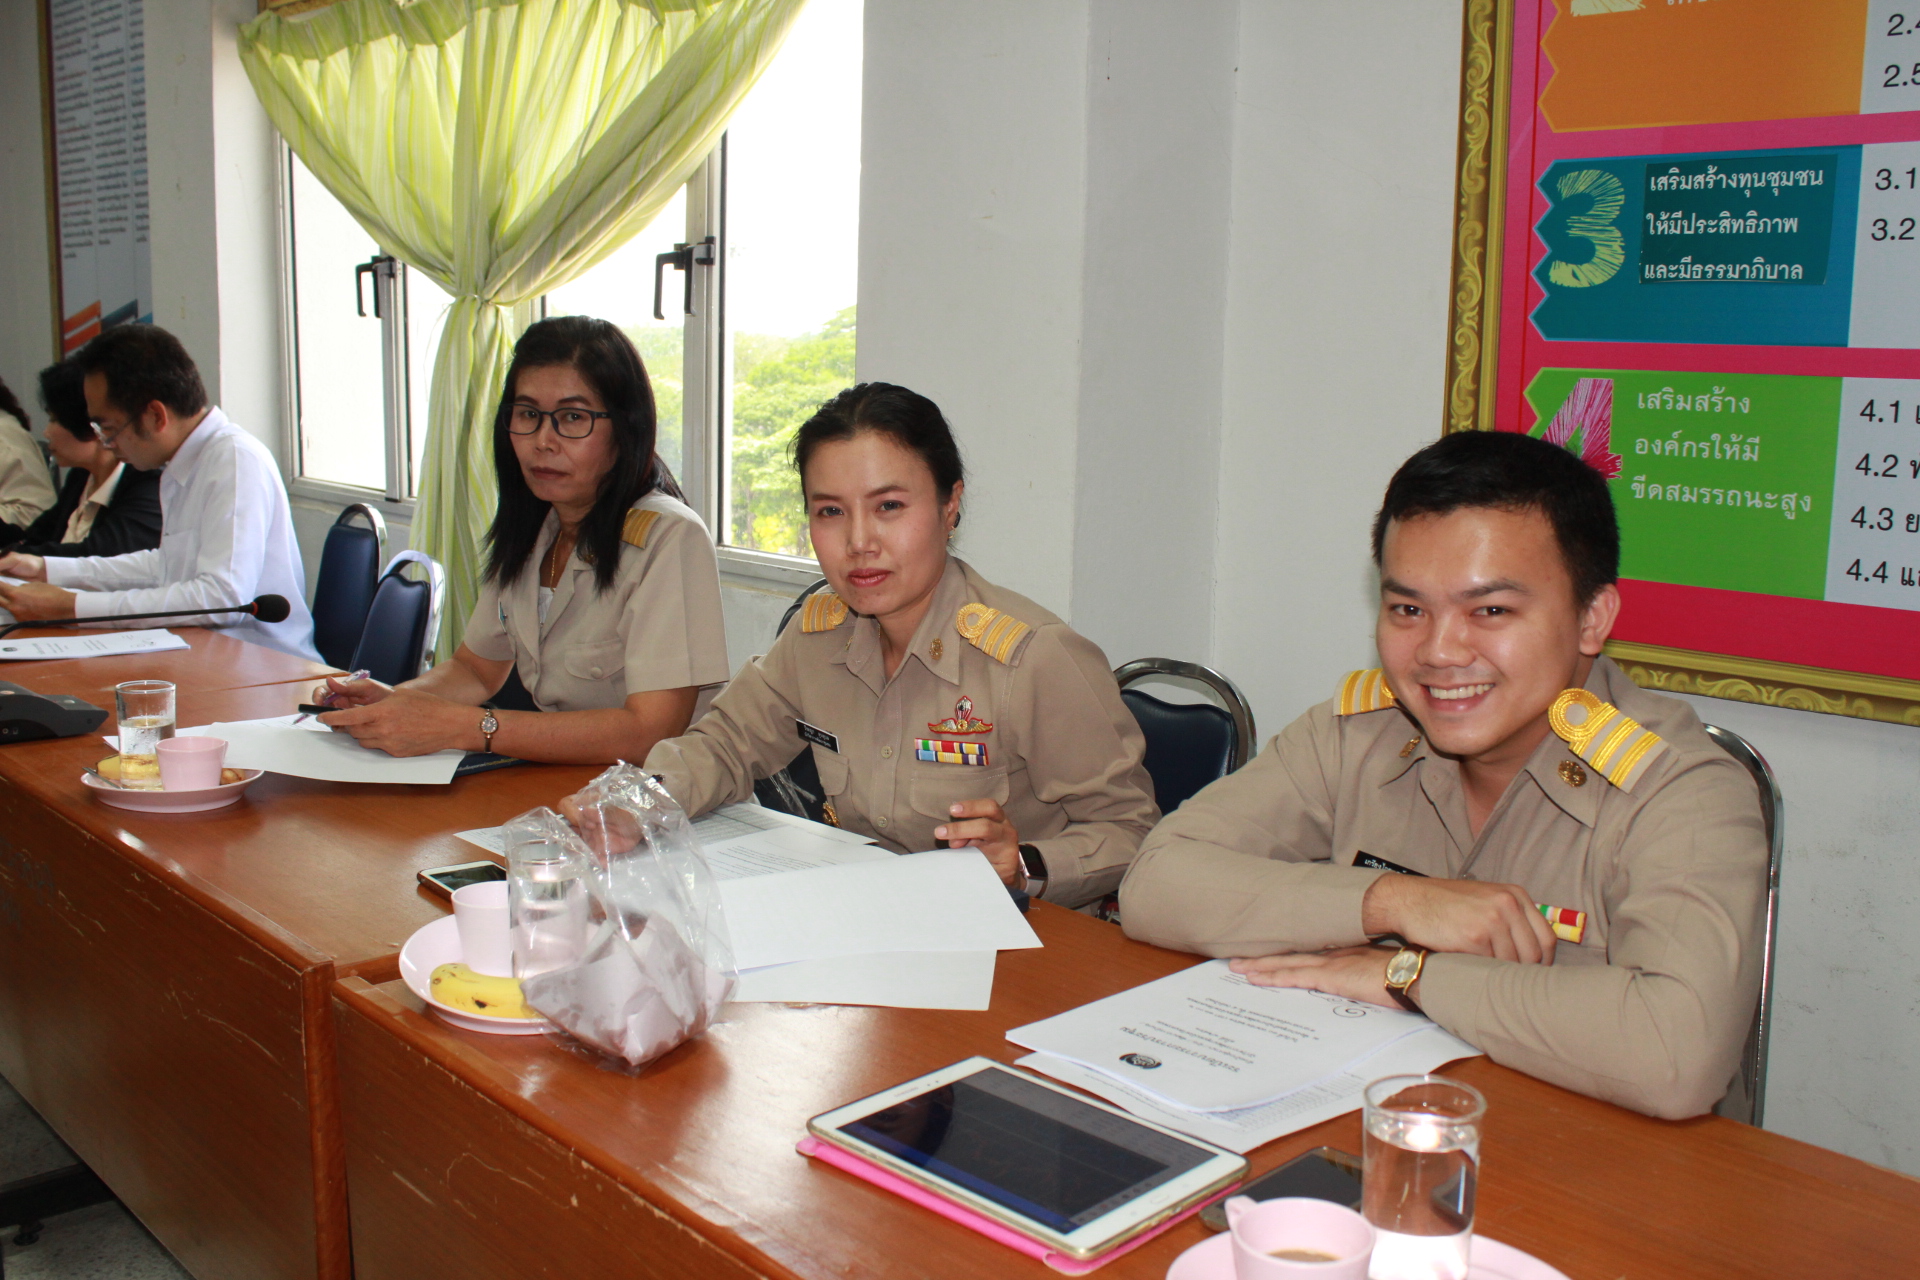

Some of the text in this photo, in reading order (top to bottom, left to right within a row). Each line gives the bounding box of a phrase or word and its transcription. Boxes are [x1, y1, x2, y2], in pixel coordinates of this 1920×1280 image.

[1650, 165, 1824, 198] เสริมสร้างทุนชุมชน
[1875, 167, 1917, 191] 3.1
[1548, 169, 1625, 288] 3
[1645, 210, 1799, 235] ให้มีประสิทธิภาพ
[1871, 218, 1916, 241] 3.2
[1644, 255, 1804, 280] และมีธรรมาภิบาล
[1638, 386, 1751, 414] เสริมสร้าง
[1859, 399, 1900, 423] 4.1
[1634, 430, 1760, 462] องค์กรให้มี
[1855, 453, 1899, 478] 4.2
[1631, 474, 1812, 520] ขีดสมรรถนะสูง
[1850, 506, 1894, 531] 4.3
[1846, 559, 1889, 584] 4.4
